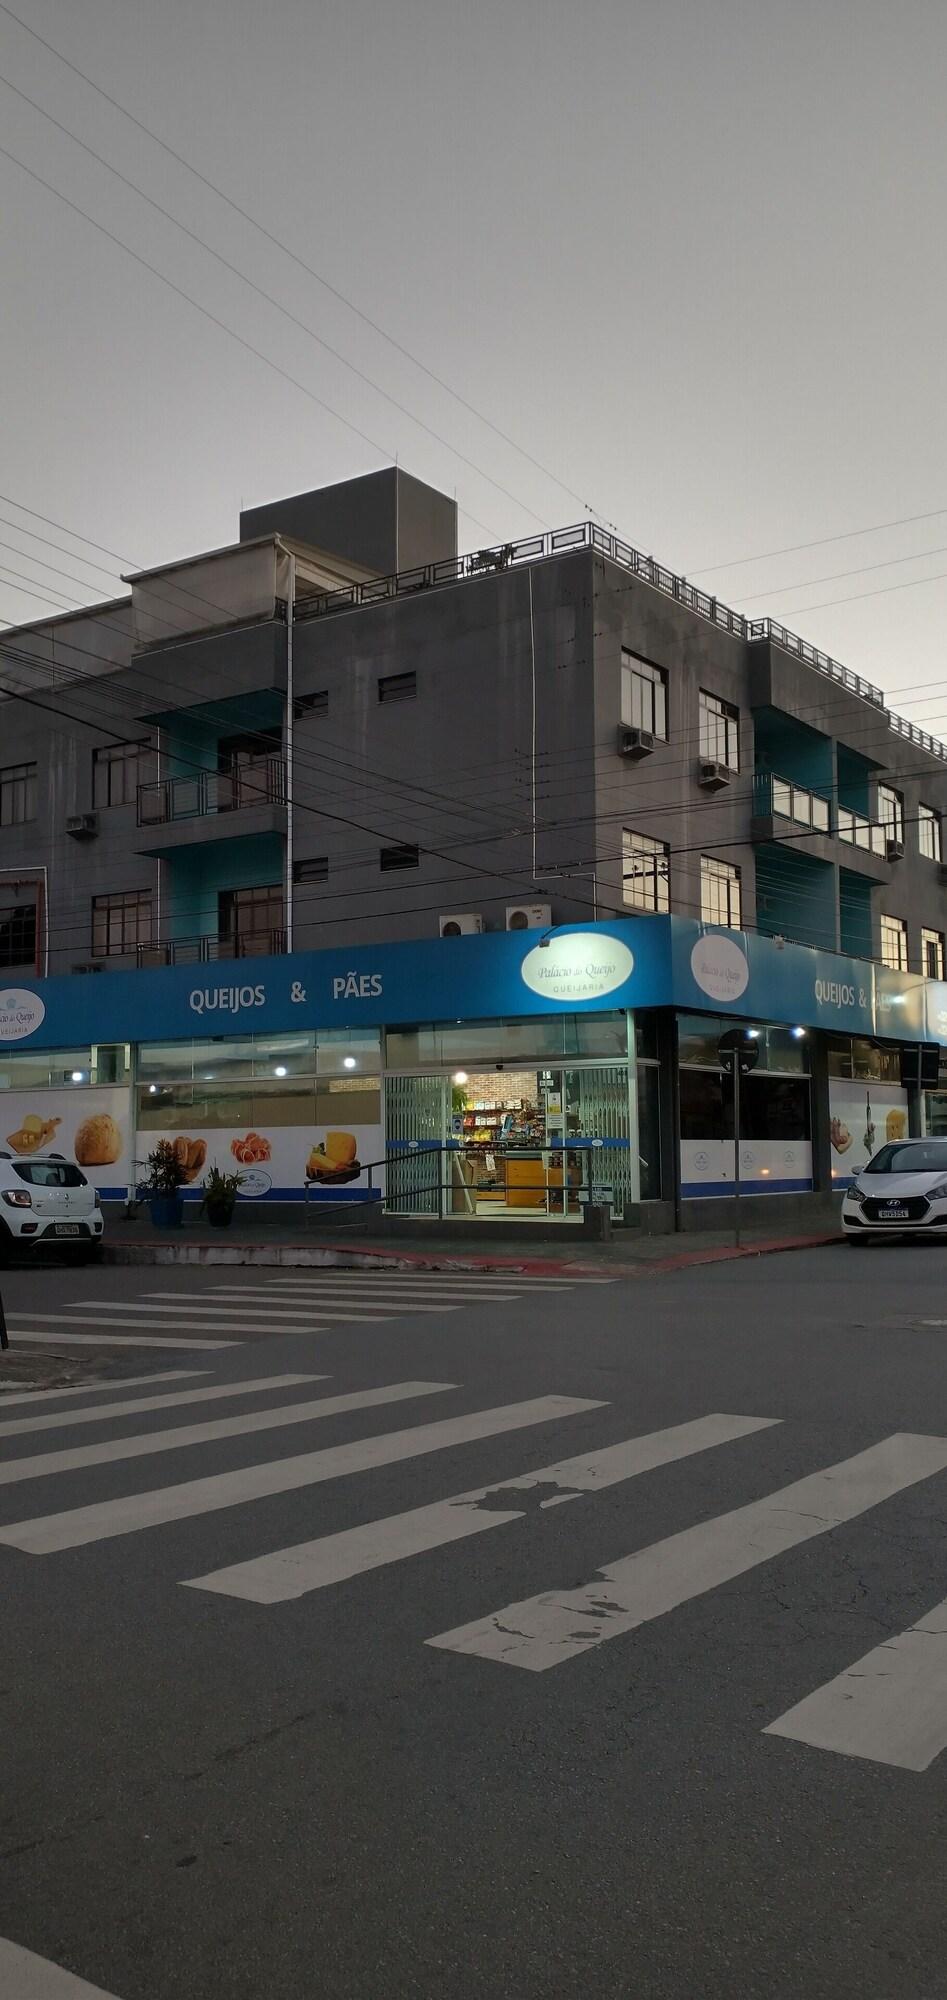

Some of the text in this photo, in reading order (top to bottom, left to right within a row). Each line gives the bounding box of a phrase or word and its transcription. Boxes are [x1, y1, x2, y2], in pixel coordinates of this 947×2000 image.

[538, 964, 571, 978] Palácio
[585, 962, 616, 979] Queijo
[190, 971, 383, 1014] QUEIJOS & PÃES
[553, 984, 604, 993] QUEIJARIA
[815, 979, 855, 1008] QUEIJOS
[859, 988, 867, 1008] &
